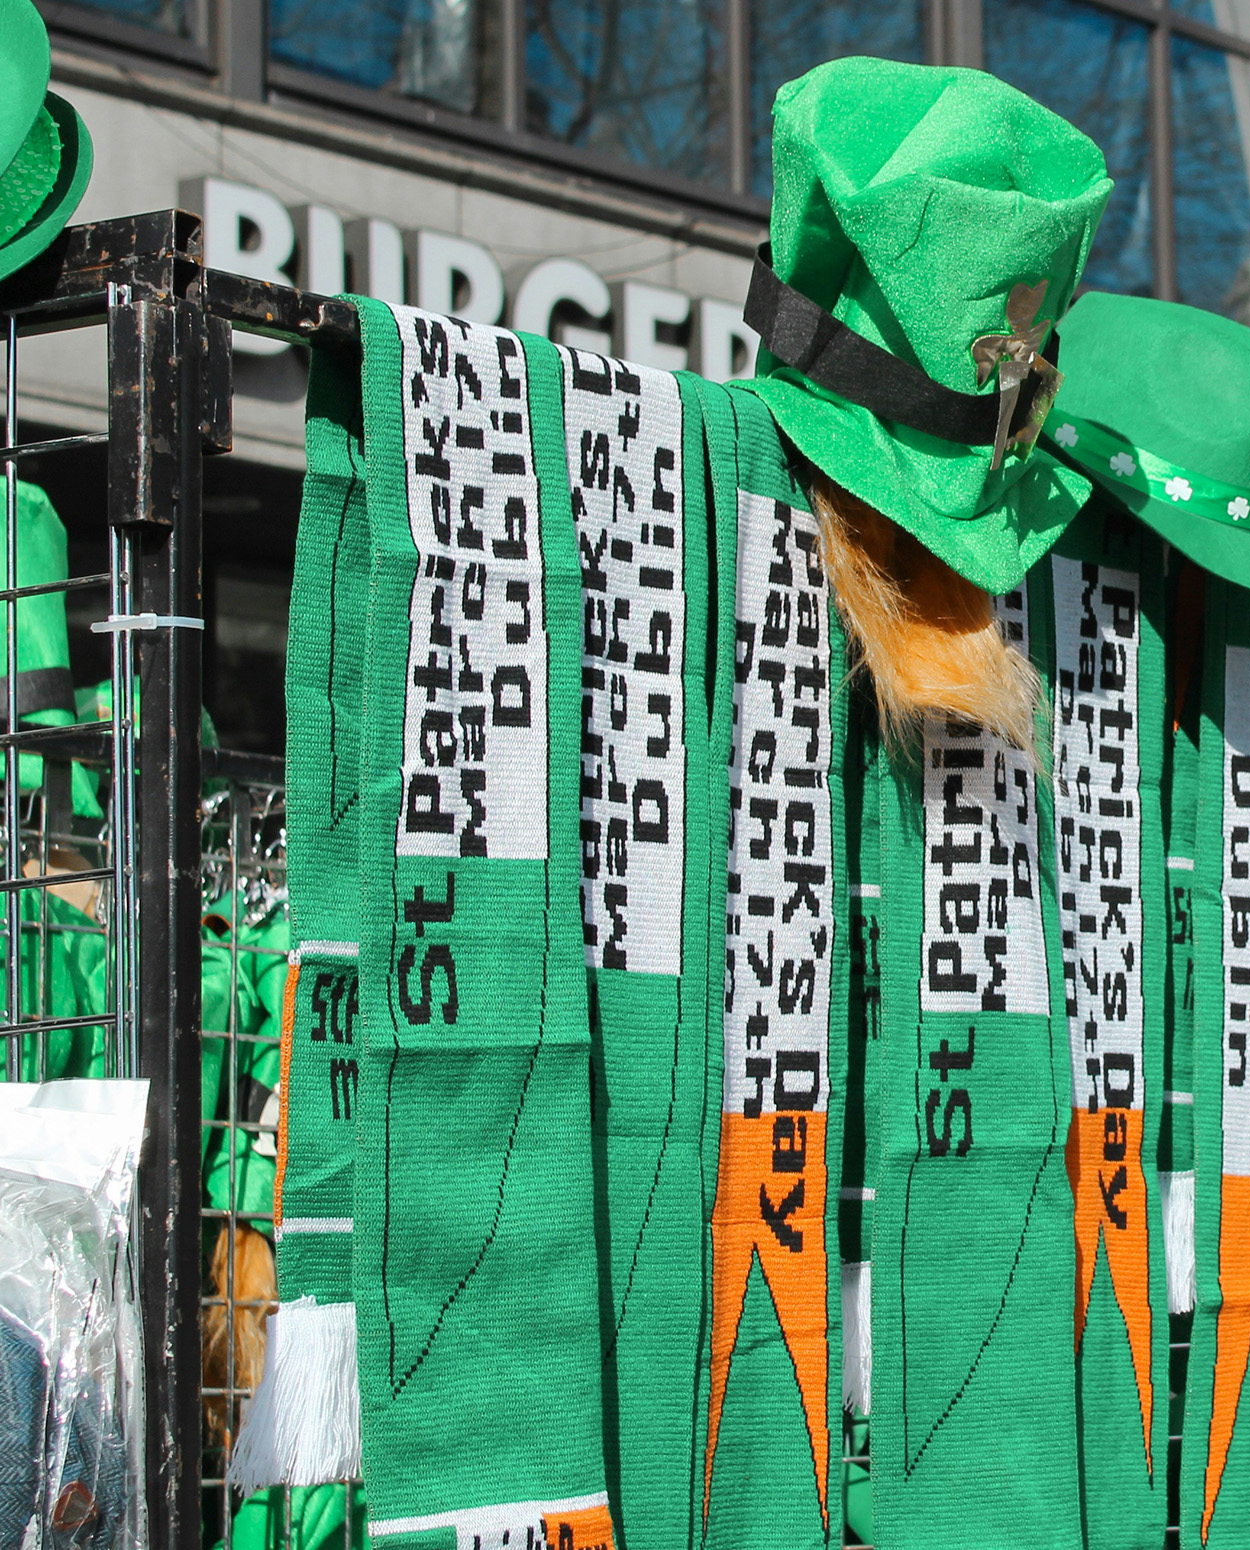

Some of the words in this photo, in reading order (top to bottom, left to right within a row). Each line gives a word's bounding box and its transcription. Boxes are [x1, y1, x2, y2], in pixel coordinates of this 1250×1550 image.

[450, 316, 484, 449] 17
[406, 317, 457, 834] Patrick's
[457, 485, 487, 857] March
[490, 337, 531, 727] Dublin
[632, 447, 674, 843] Dublin
[749, 501, 793, 860] March
[603, 598, 629, 970] March
[778, 529, 826, 1014] Patrick's
[929, 716, 983, 992] Patri
[1076, 561, 1098, 881] March
[1100, 586, 1134, 1020] Patrick's
[400, 872, 458, 1025] St
[744, 896, 775, 1118] 17th
[982, 751, 1007, 1011] Marc
[1080, 915, 1099, 1113] 17th
[760, 1050, 820, 1252] Day
[926, 1027, 974, 1157] St
[1099, 1054, 1134, 1229] Day
